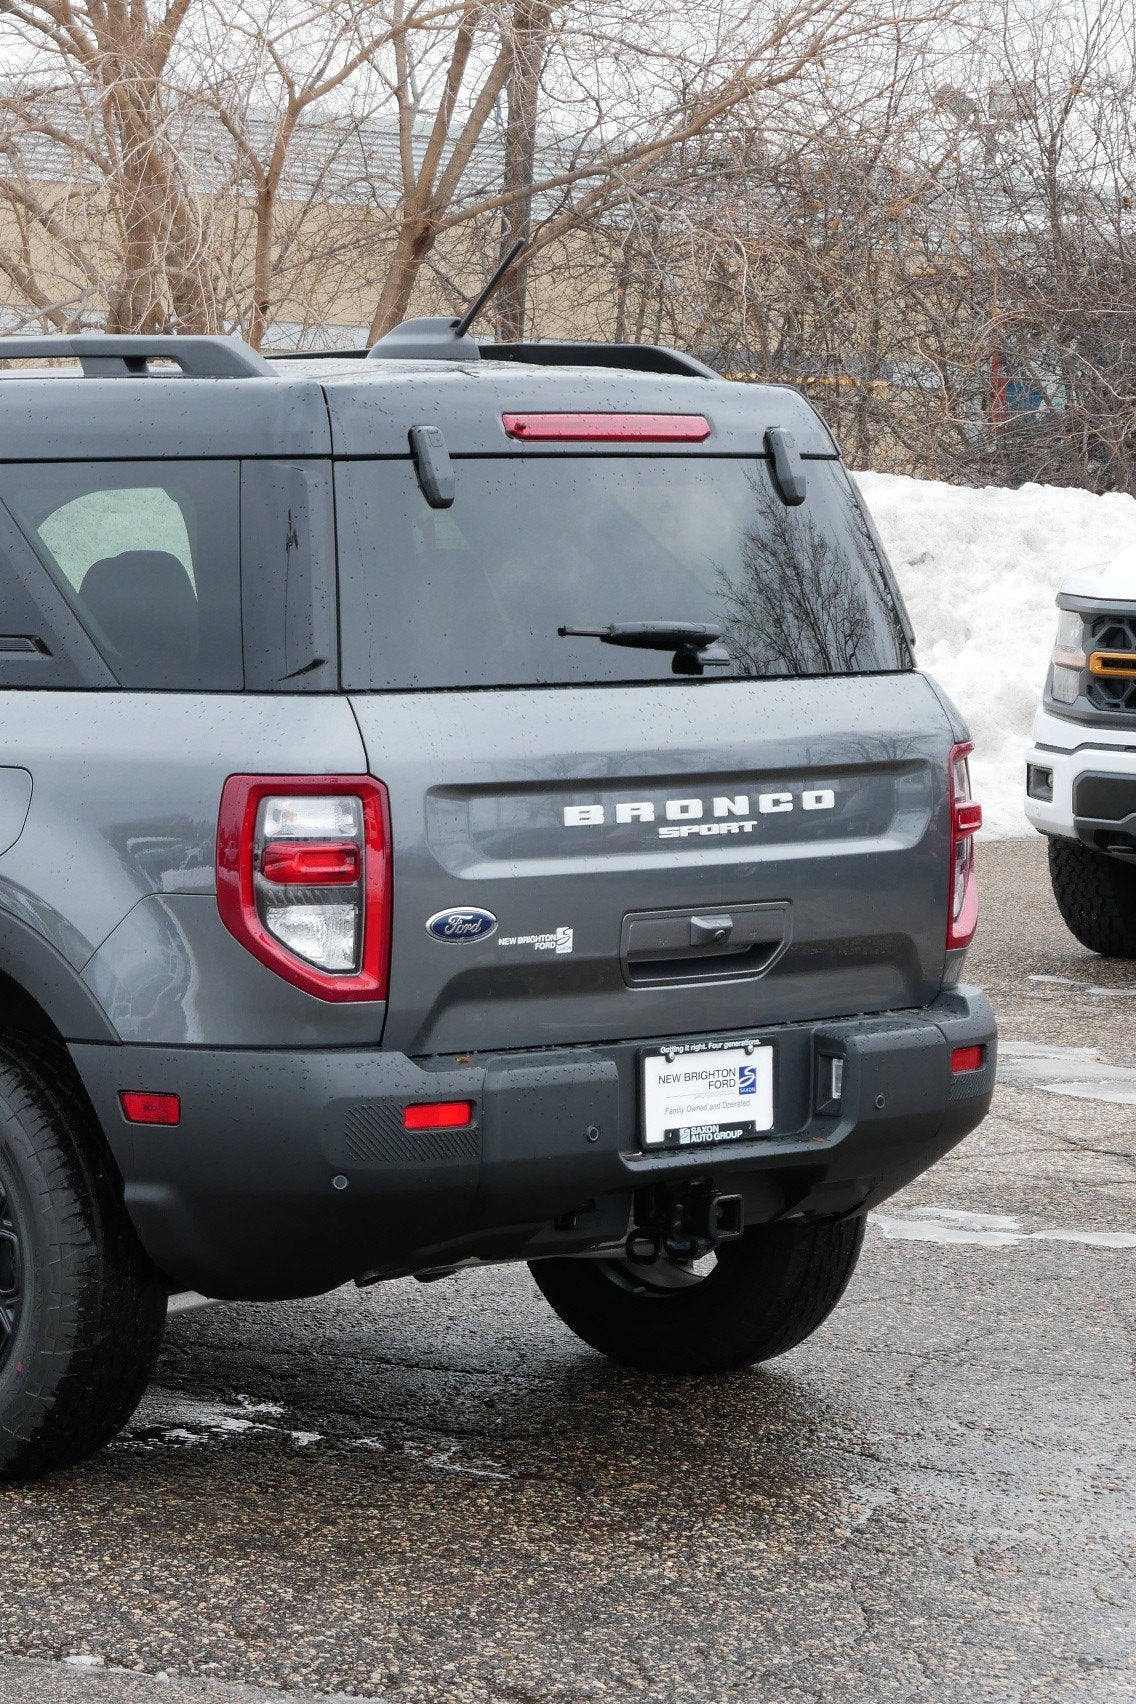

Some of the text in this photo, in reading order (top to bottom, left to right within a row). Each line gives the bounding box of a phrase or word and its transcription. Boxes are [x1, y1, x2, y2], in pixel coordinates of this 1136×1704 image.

[563, 789, 835, 827] BRONCO
[658, 820, 758, 839] SPORT
[444, 914, 482, 935] Ford
[498, 933, 557, 946] NEW BRIGHTON
[534, 941, 556, 950] FORD
[660, 1045, 684, 1054] Getting
[708, 1042, 724, 1050] Four
[658, 1067, 736, 1085] NEW BRIGHTON
[708, 1078, 736, 1090] FORD
[664, 1098, 751, 1116] Family Owned and Operated
[690, 1124, 720, 1135] SAXON
[690, 1129, 743, 1143] AUTO GROUP
